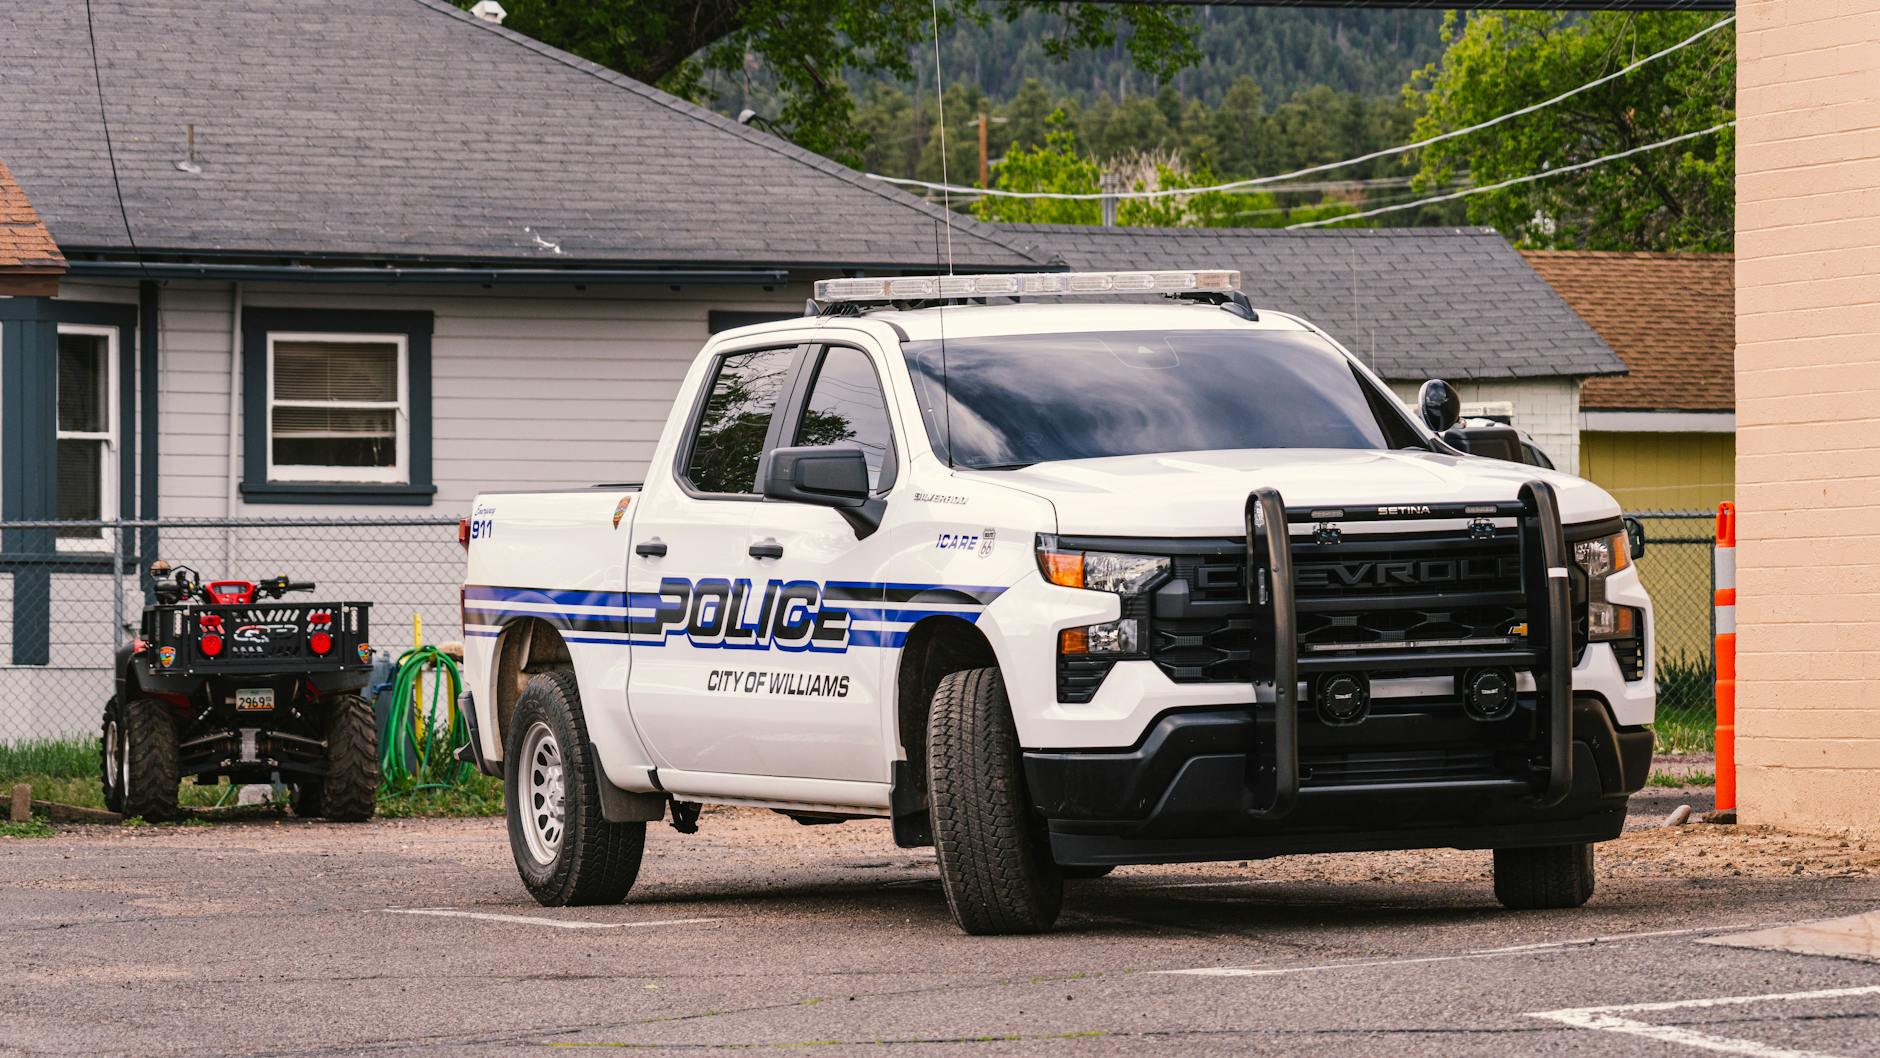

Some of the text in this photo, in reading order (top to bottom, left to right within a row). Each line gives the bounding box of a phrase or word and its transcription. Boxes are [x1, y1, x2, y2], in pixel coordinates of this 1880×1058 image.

[1377, 505, 1431, 515] SETINA
[472, 520, 492, 539] 911
[980, 540, 993, 555] 66
[656, 577, 851, 654] POLICE
[707, 669, 850, 697] CITY OF WILLIAMS
[238, 696, 265, 708] 2969
